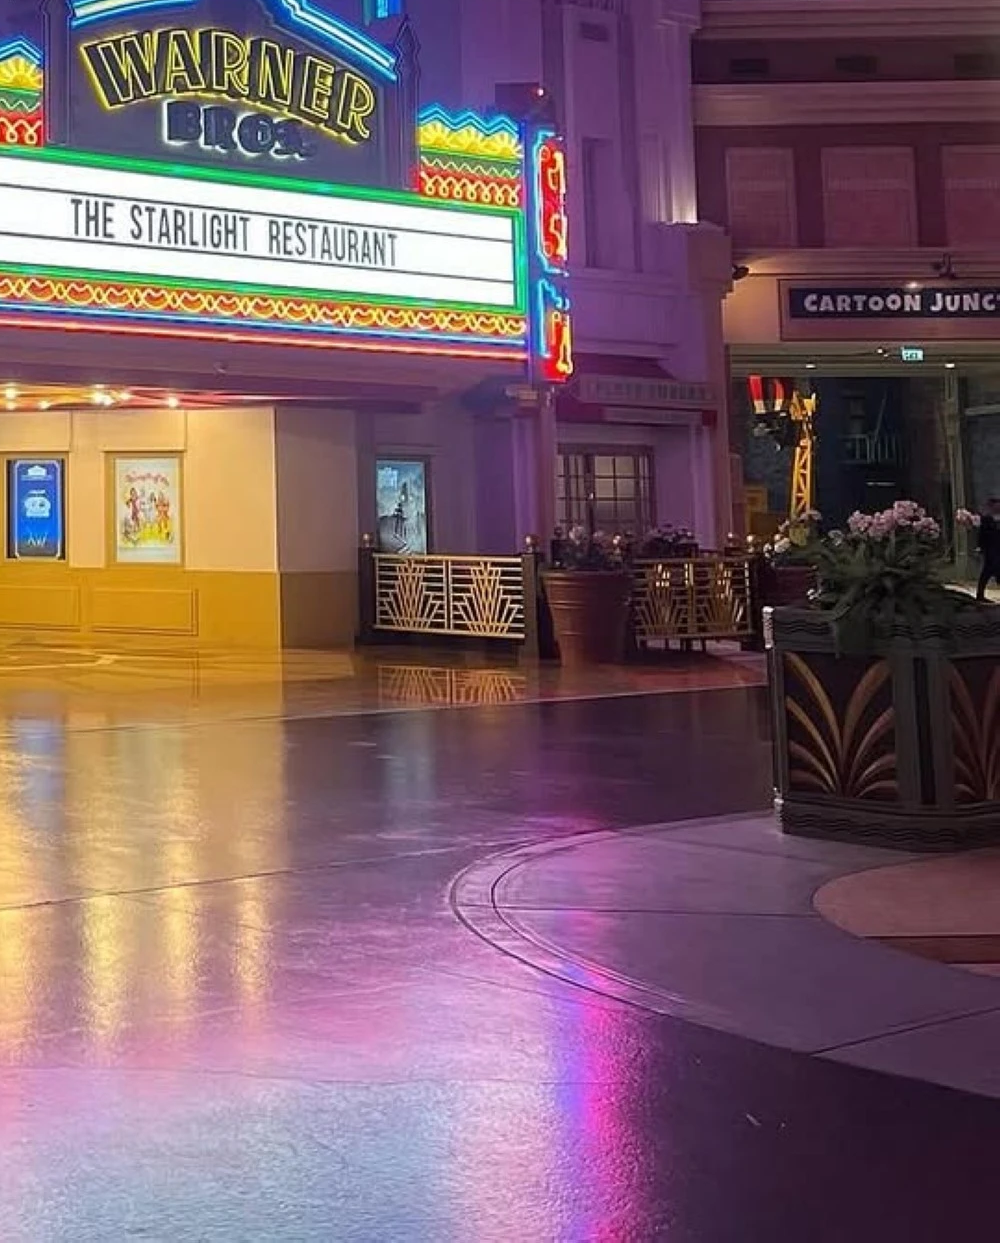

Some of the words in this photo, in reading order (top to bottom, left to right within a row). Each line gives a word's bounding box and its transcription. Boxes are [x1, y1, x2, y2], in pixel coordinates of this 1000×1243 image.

[81, 28, 375, 144] WARNER
[71, 198, 115, 239] THE
[130, 204, 250, 252] STARLIGHT
[268, 218, 398, 267] RESTAURANT
[804, 293, 921, 312] CARTOON
